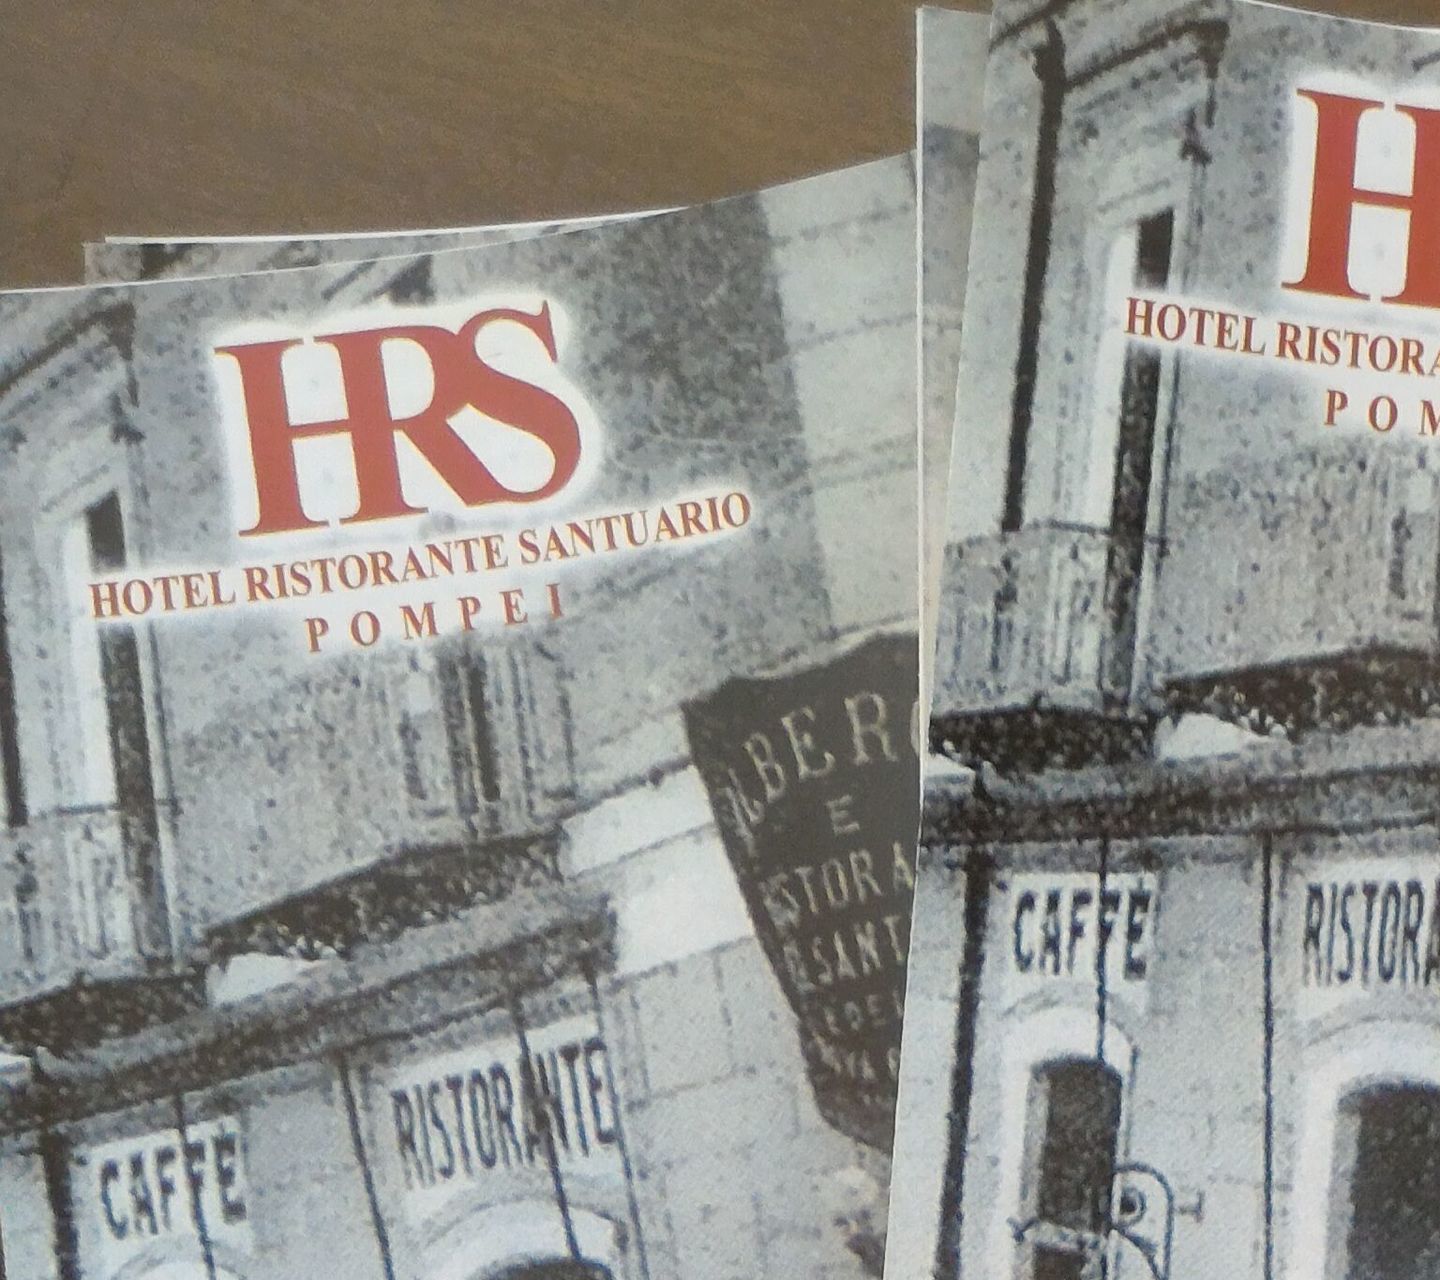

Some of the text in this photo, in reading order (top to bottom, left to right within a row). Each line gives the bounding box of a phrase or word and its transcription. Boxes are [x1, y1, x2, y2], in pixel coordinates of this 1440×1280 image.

[1125, 297, 1266, 355] HOTEL
[214, 302, 583, 538] HRS
[88, 493, 753, 620] HOTEL RISTORANTE SANTUARIO
[306, 583, 566, 652] POMPEI
[827, 795, 861, 834] E
[391, 1039, 618, 1190] RISTORANTE
